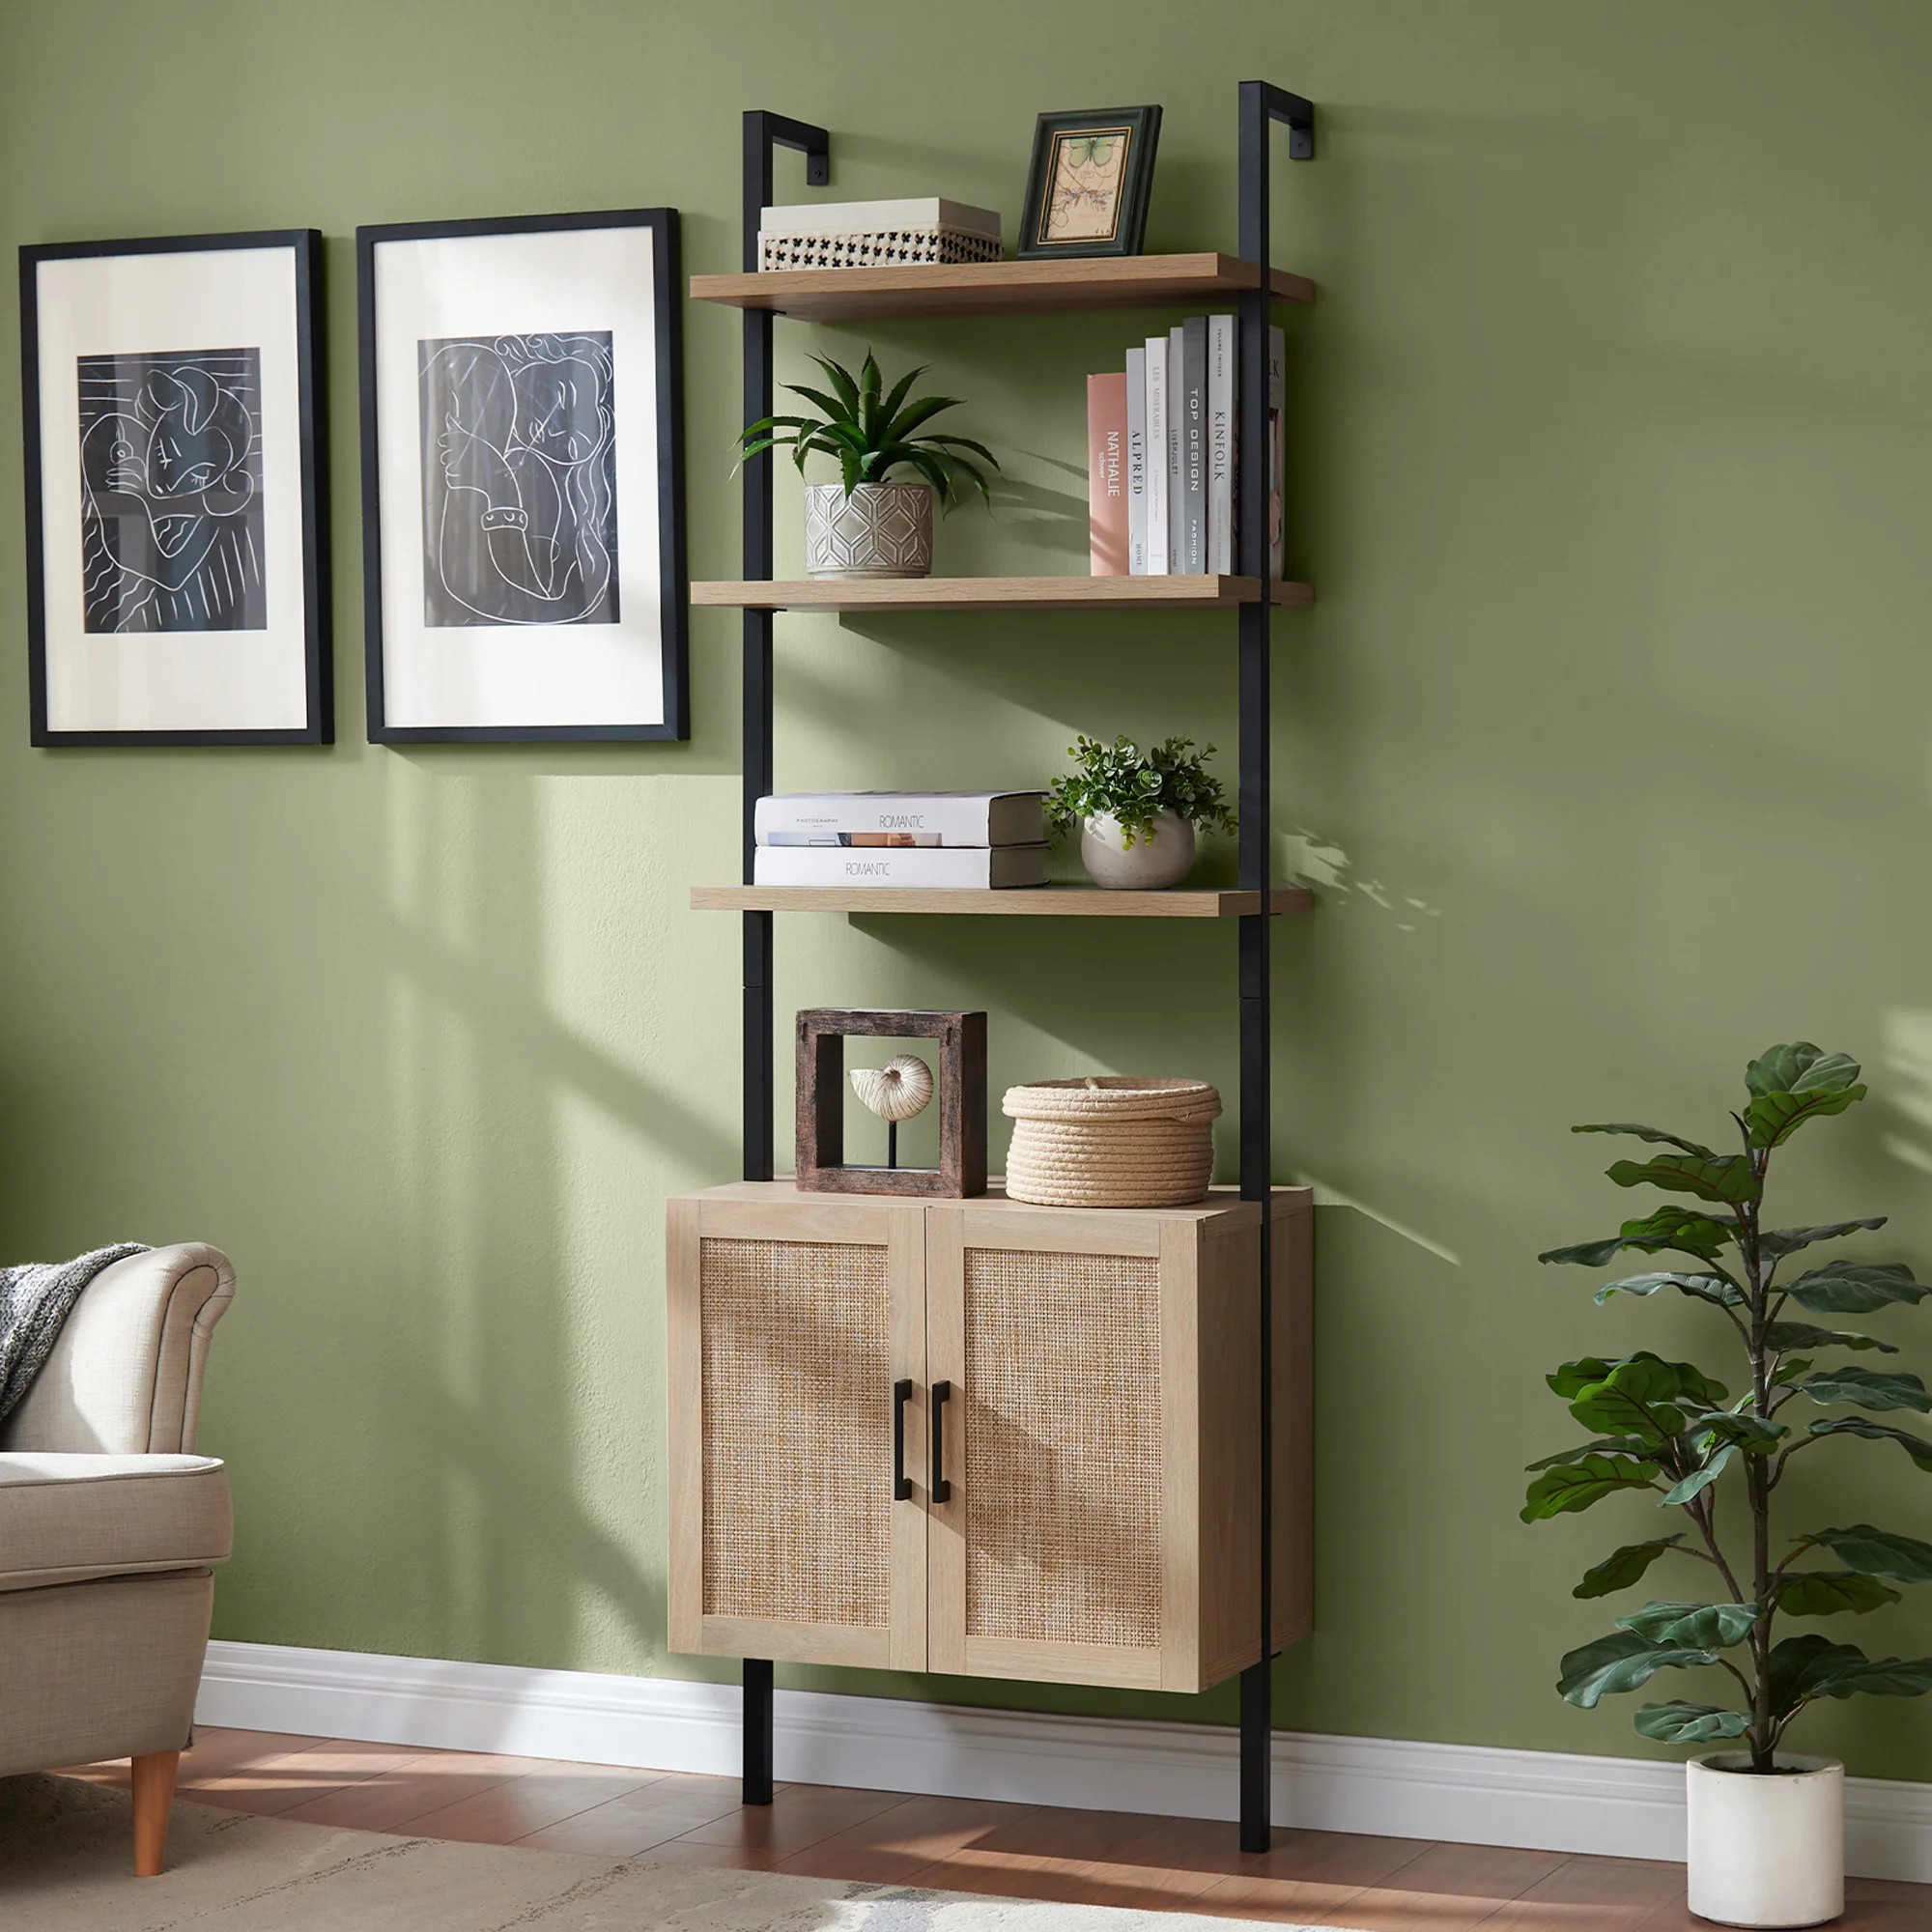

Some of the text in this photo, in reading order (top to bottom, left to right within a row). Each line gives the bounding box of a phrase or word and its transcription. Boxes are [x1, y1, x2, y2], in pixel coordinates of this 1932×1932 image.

[1151, 387, 1160, 440] MISERABLES
[1107, 431, 1121, 497] NATHALIE
[1131, 430, 1142, 496] ALPRED
[1190, 429, 1199, 492] DESIGN
[1214, 411, 1226, 480] KINFOLK
[879, 814, 924, 829] ROMANTIC
[845, 862, 891, 876] ROMANTIC
